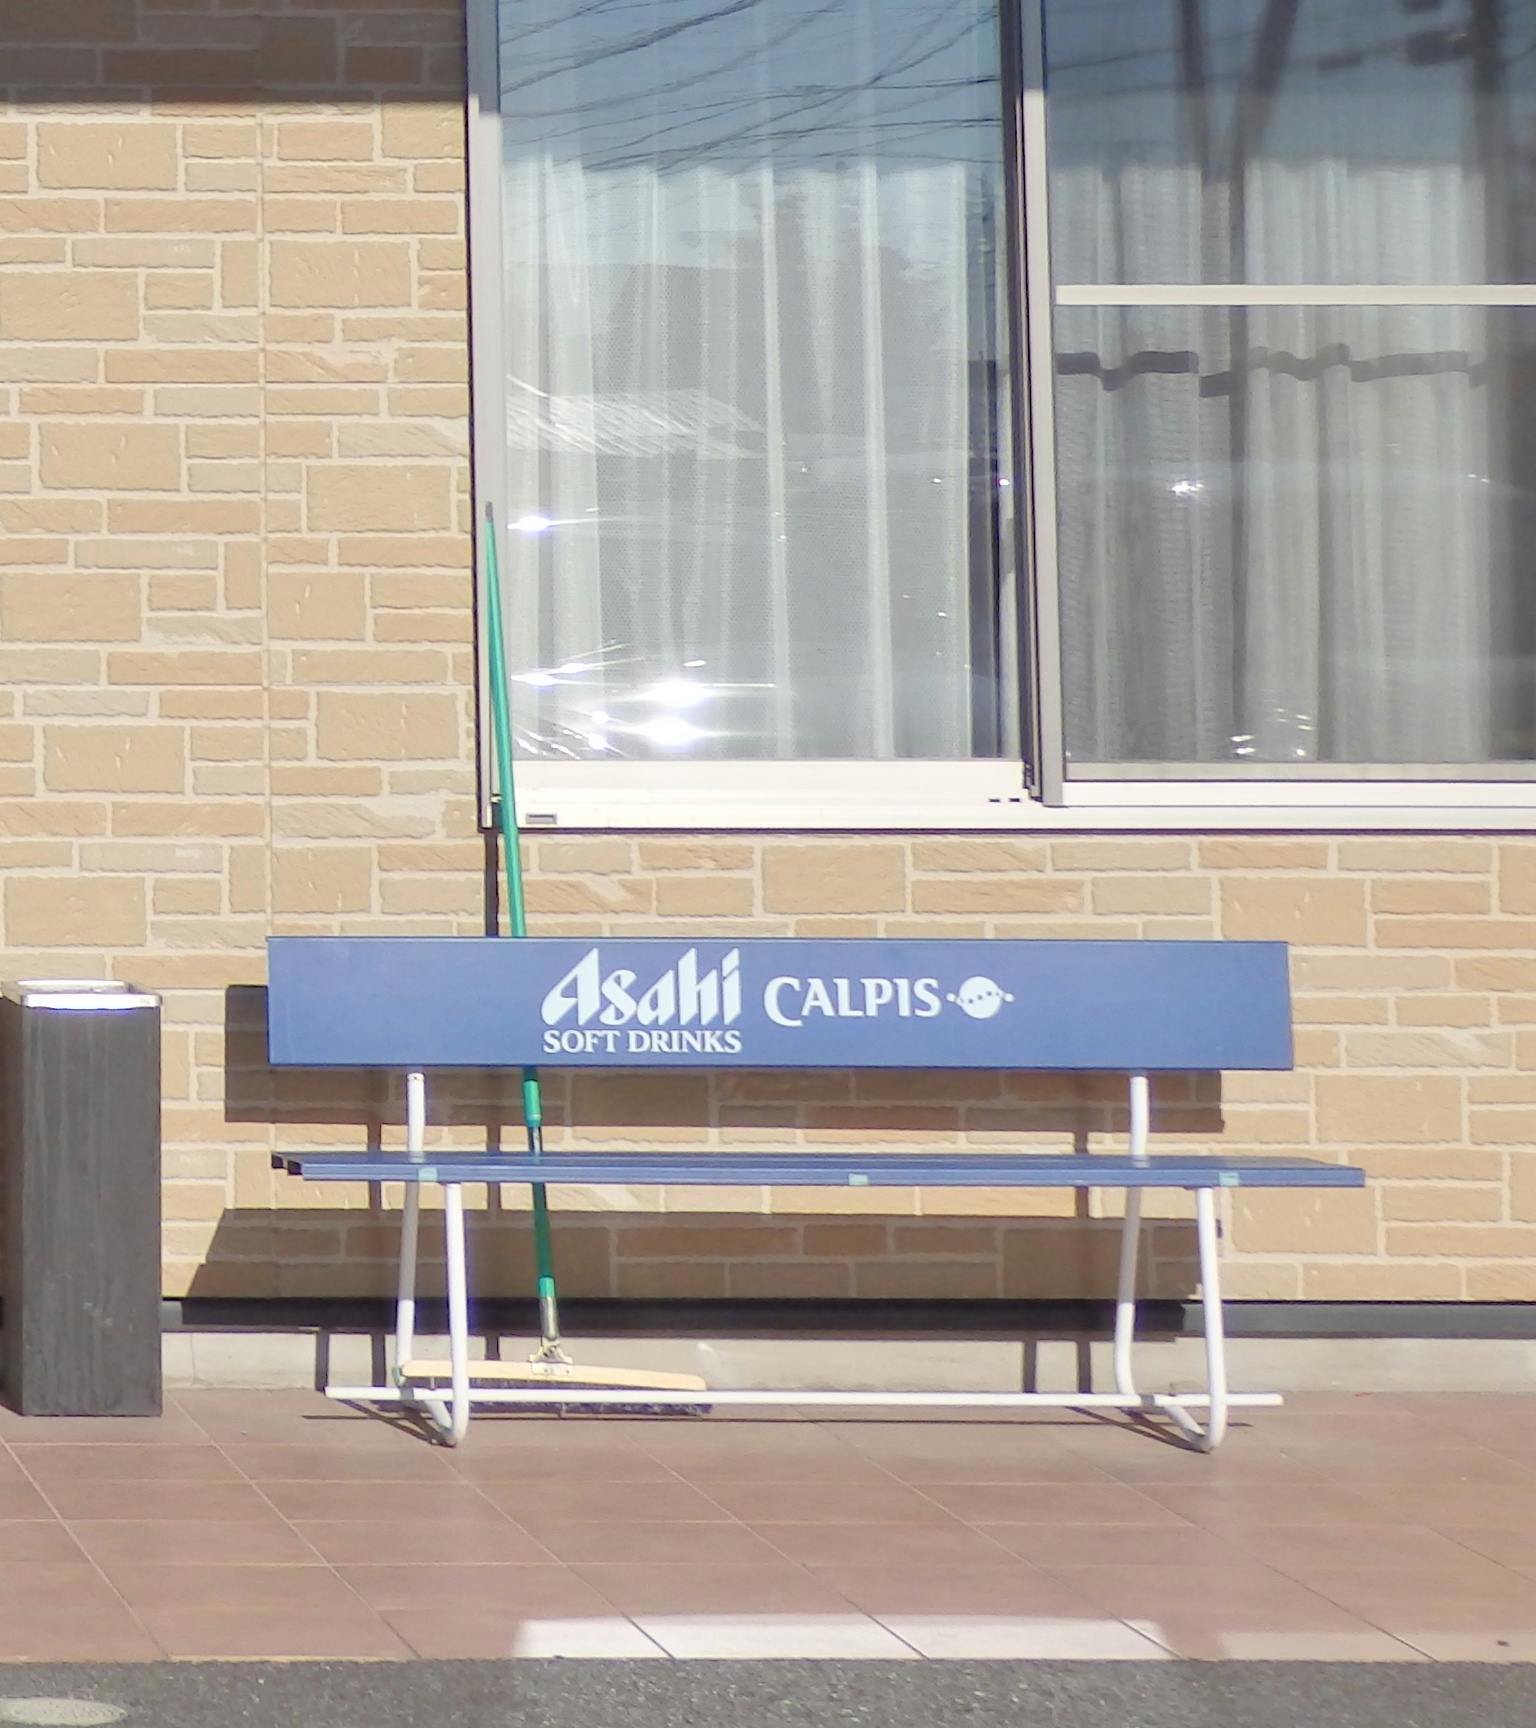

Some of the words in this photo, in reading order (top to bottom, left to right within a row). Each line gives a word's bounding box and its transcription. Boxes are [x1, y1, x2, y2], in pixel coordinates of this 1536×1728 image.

[541, 947, 741, 1026] Asahi
[763, 976, 942, 1027] CALPIS
[543, 1029, 621, 1053] SOFT
[627, 1029, 742, 1053] DRINKS
